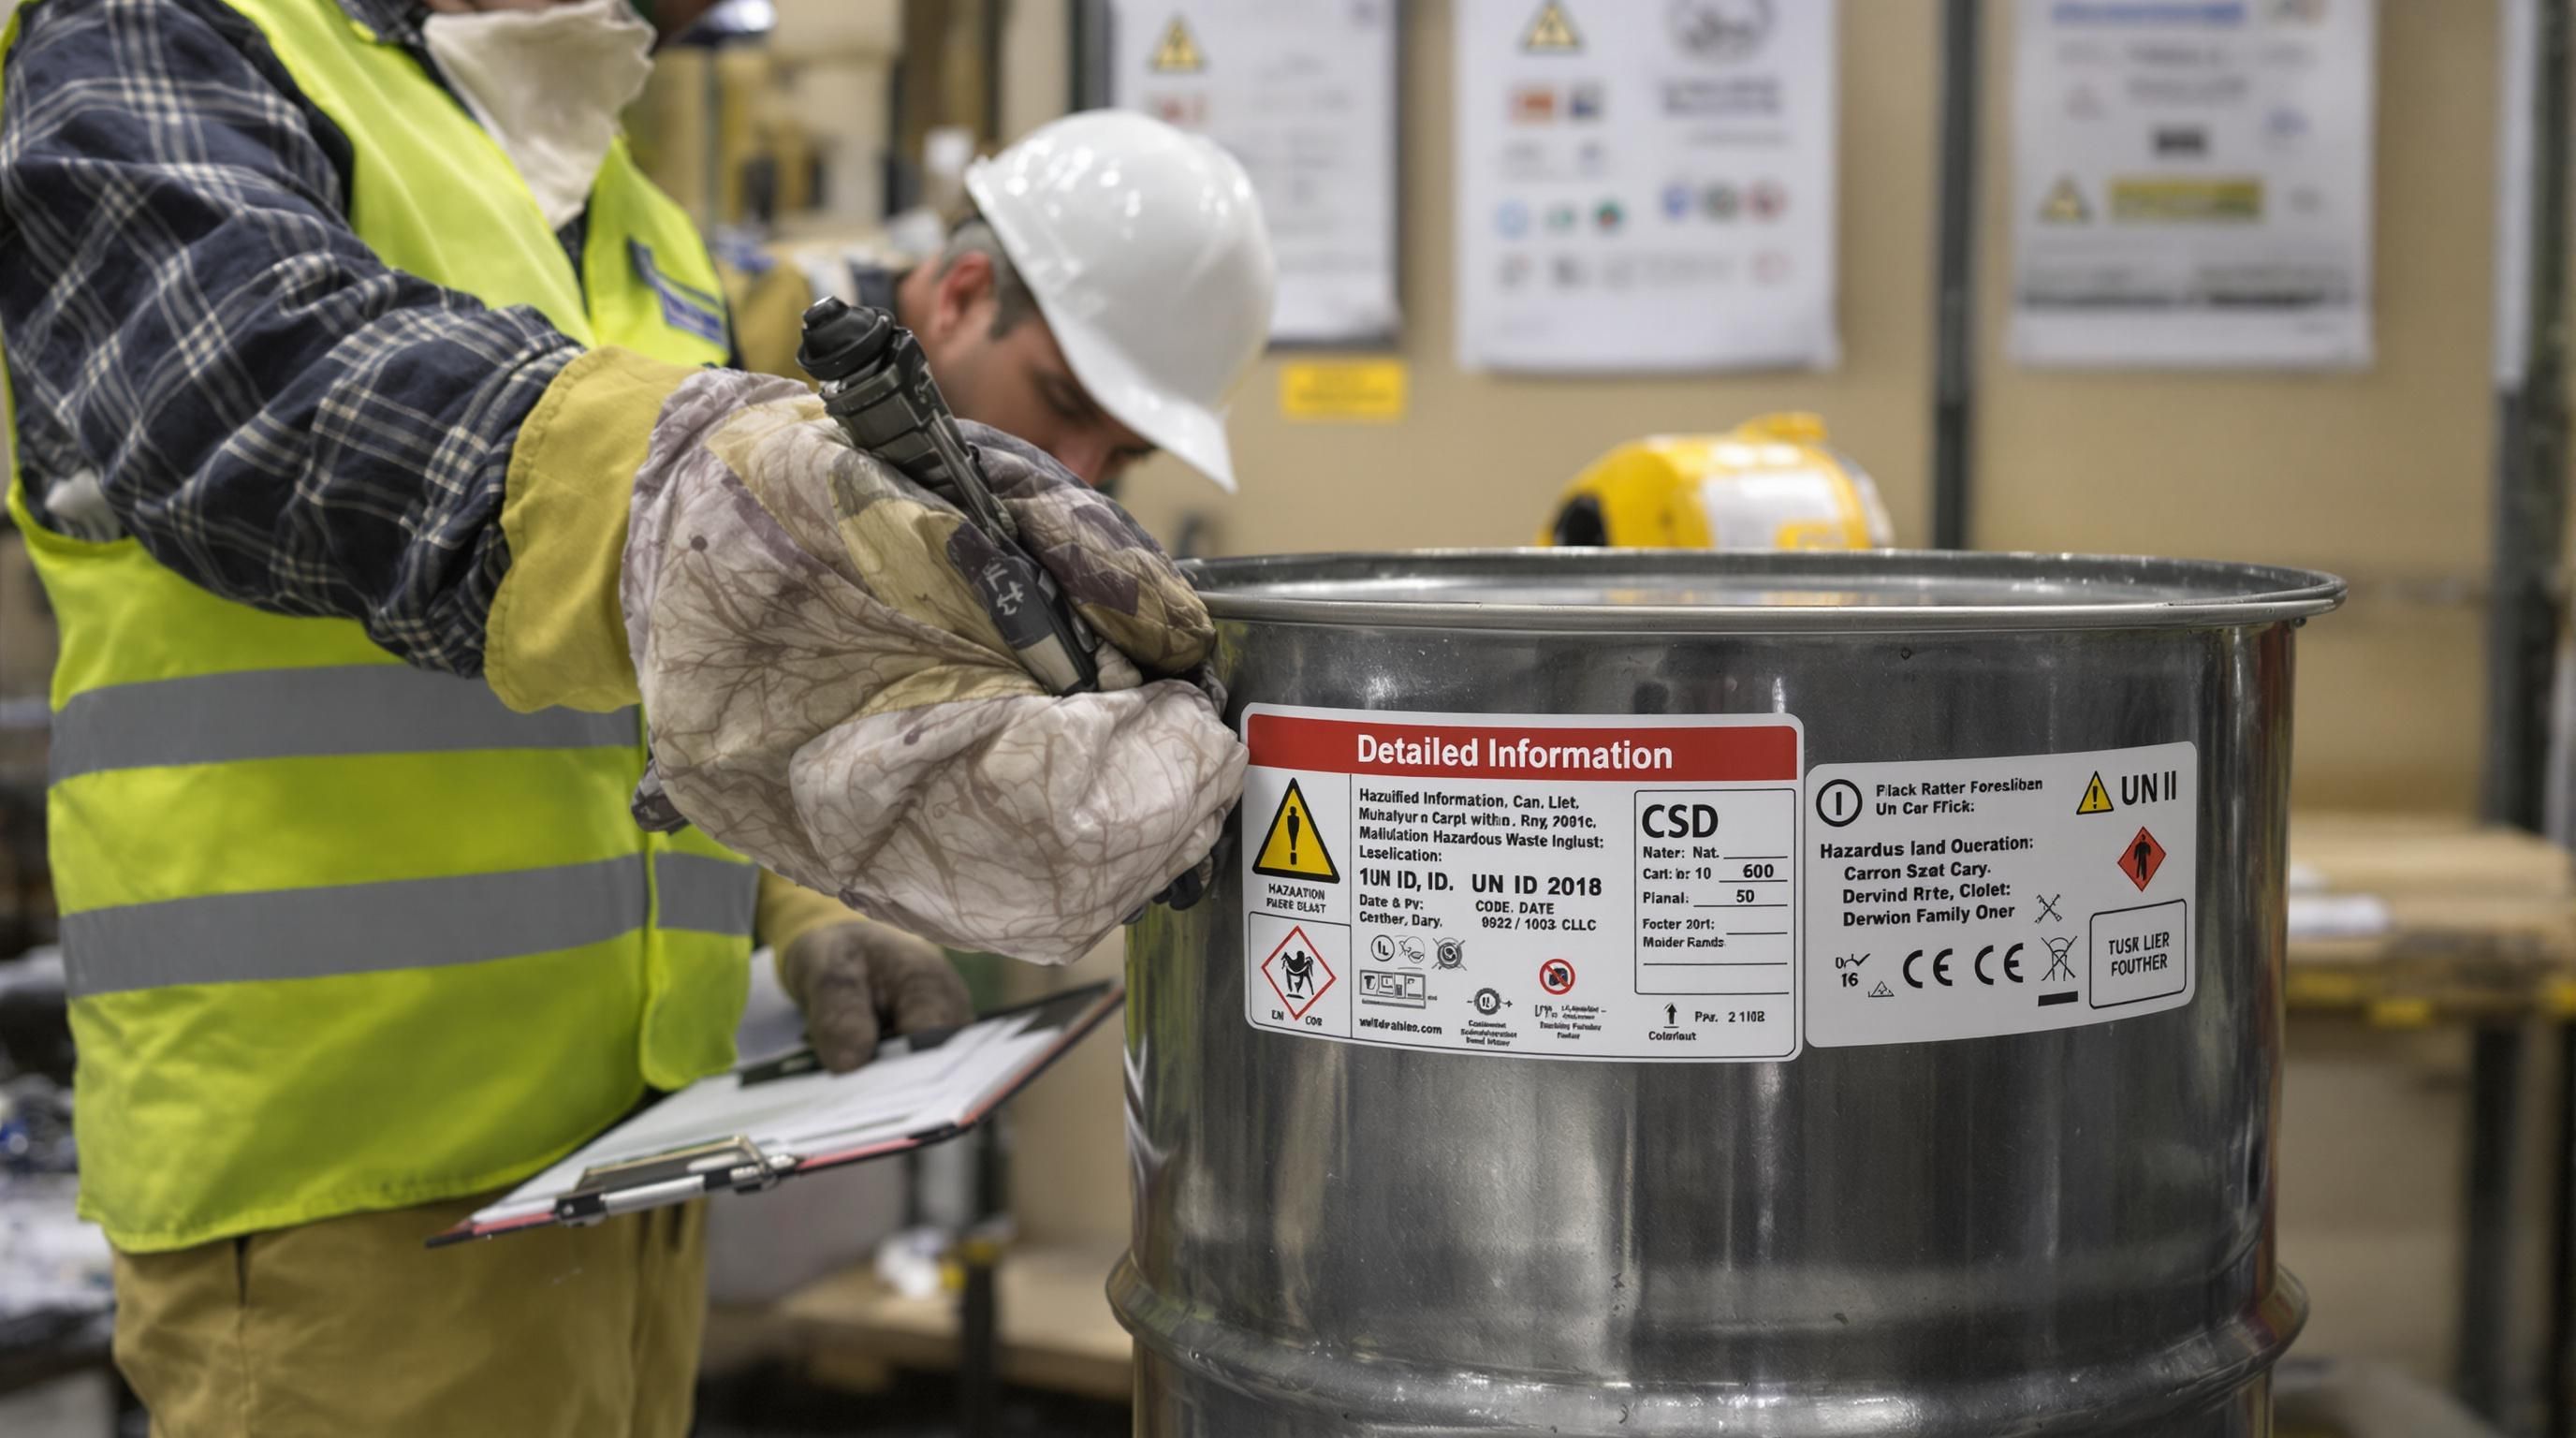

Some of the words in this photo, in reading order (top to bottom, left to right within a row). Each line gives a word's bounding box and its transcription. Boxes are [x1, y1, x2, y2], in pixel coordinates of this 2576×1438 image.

[1358, 734, 1478, 766] Detailed
[1489, 739, 1672, 769] Information
[1922, 783, 1966, 796] Ratter
[2122, 773, 2157, 805] UN
[1877, 802, 1896, 815] Un
[1642, 804, 1718, 838] CSD
[1434, 830, 1501, 845] Hazardous
[1506, 833, 1547, 846] Waste
[1644, 846, 1684, 858] Nater:
[1693, 846, 1719, 858] Nat.
[1821, 843, 1904, 858] Hazardus
[1696, 867, 1711, 879] 10
[1743, 864, 1774, 878] 600
[1844, 867, 1900, 880] Carron
[1951, 862, 1991, 878] Cary.
[1398, 871, 1421, 892] ID,
[1428, 872, 1453, 890] ID.
[1472, 873, 1503, 893] UN
[1515, 875, 1537, 894] ID
[1548, 877, 1602, 896] 2018
[1360, 894, 1388, 907] Date
[1736, 889, 1754, 902] 50
[1843, 888, 1907, 903] Dervind
[1476, 900, 1513, 913] CODE.
[1519, 902, 1554, 915] DATE
[1844, 911, 1910, 926] Derwion
[1917, 906, 1969, 924] Family
[1976, 904, 2014, 919] Oner
[1412, 914, 1442, 929] Dary.
[1562, 919, 1596, 931] CLLC
[2111, 953, 2168, 976] FOUTHER
[1842, 973, 1858, 987] 16
